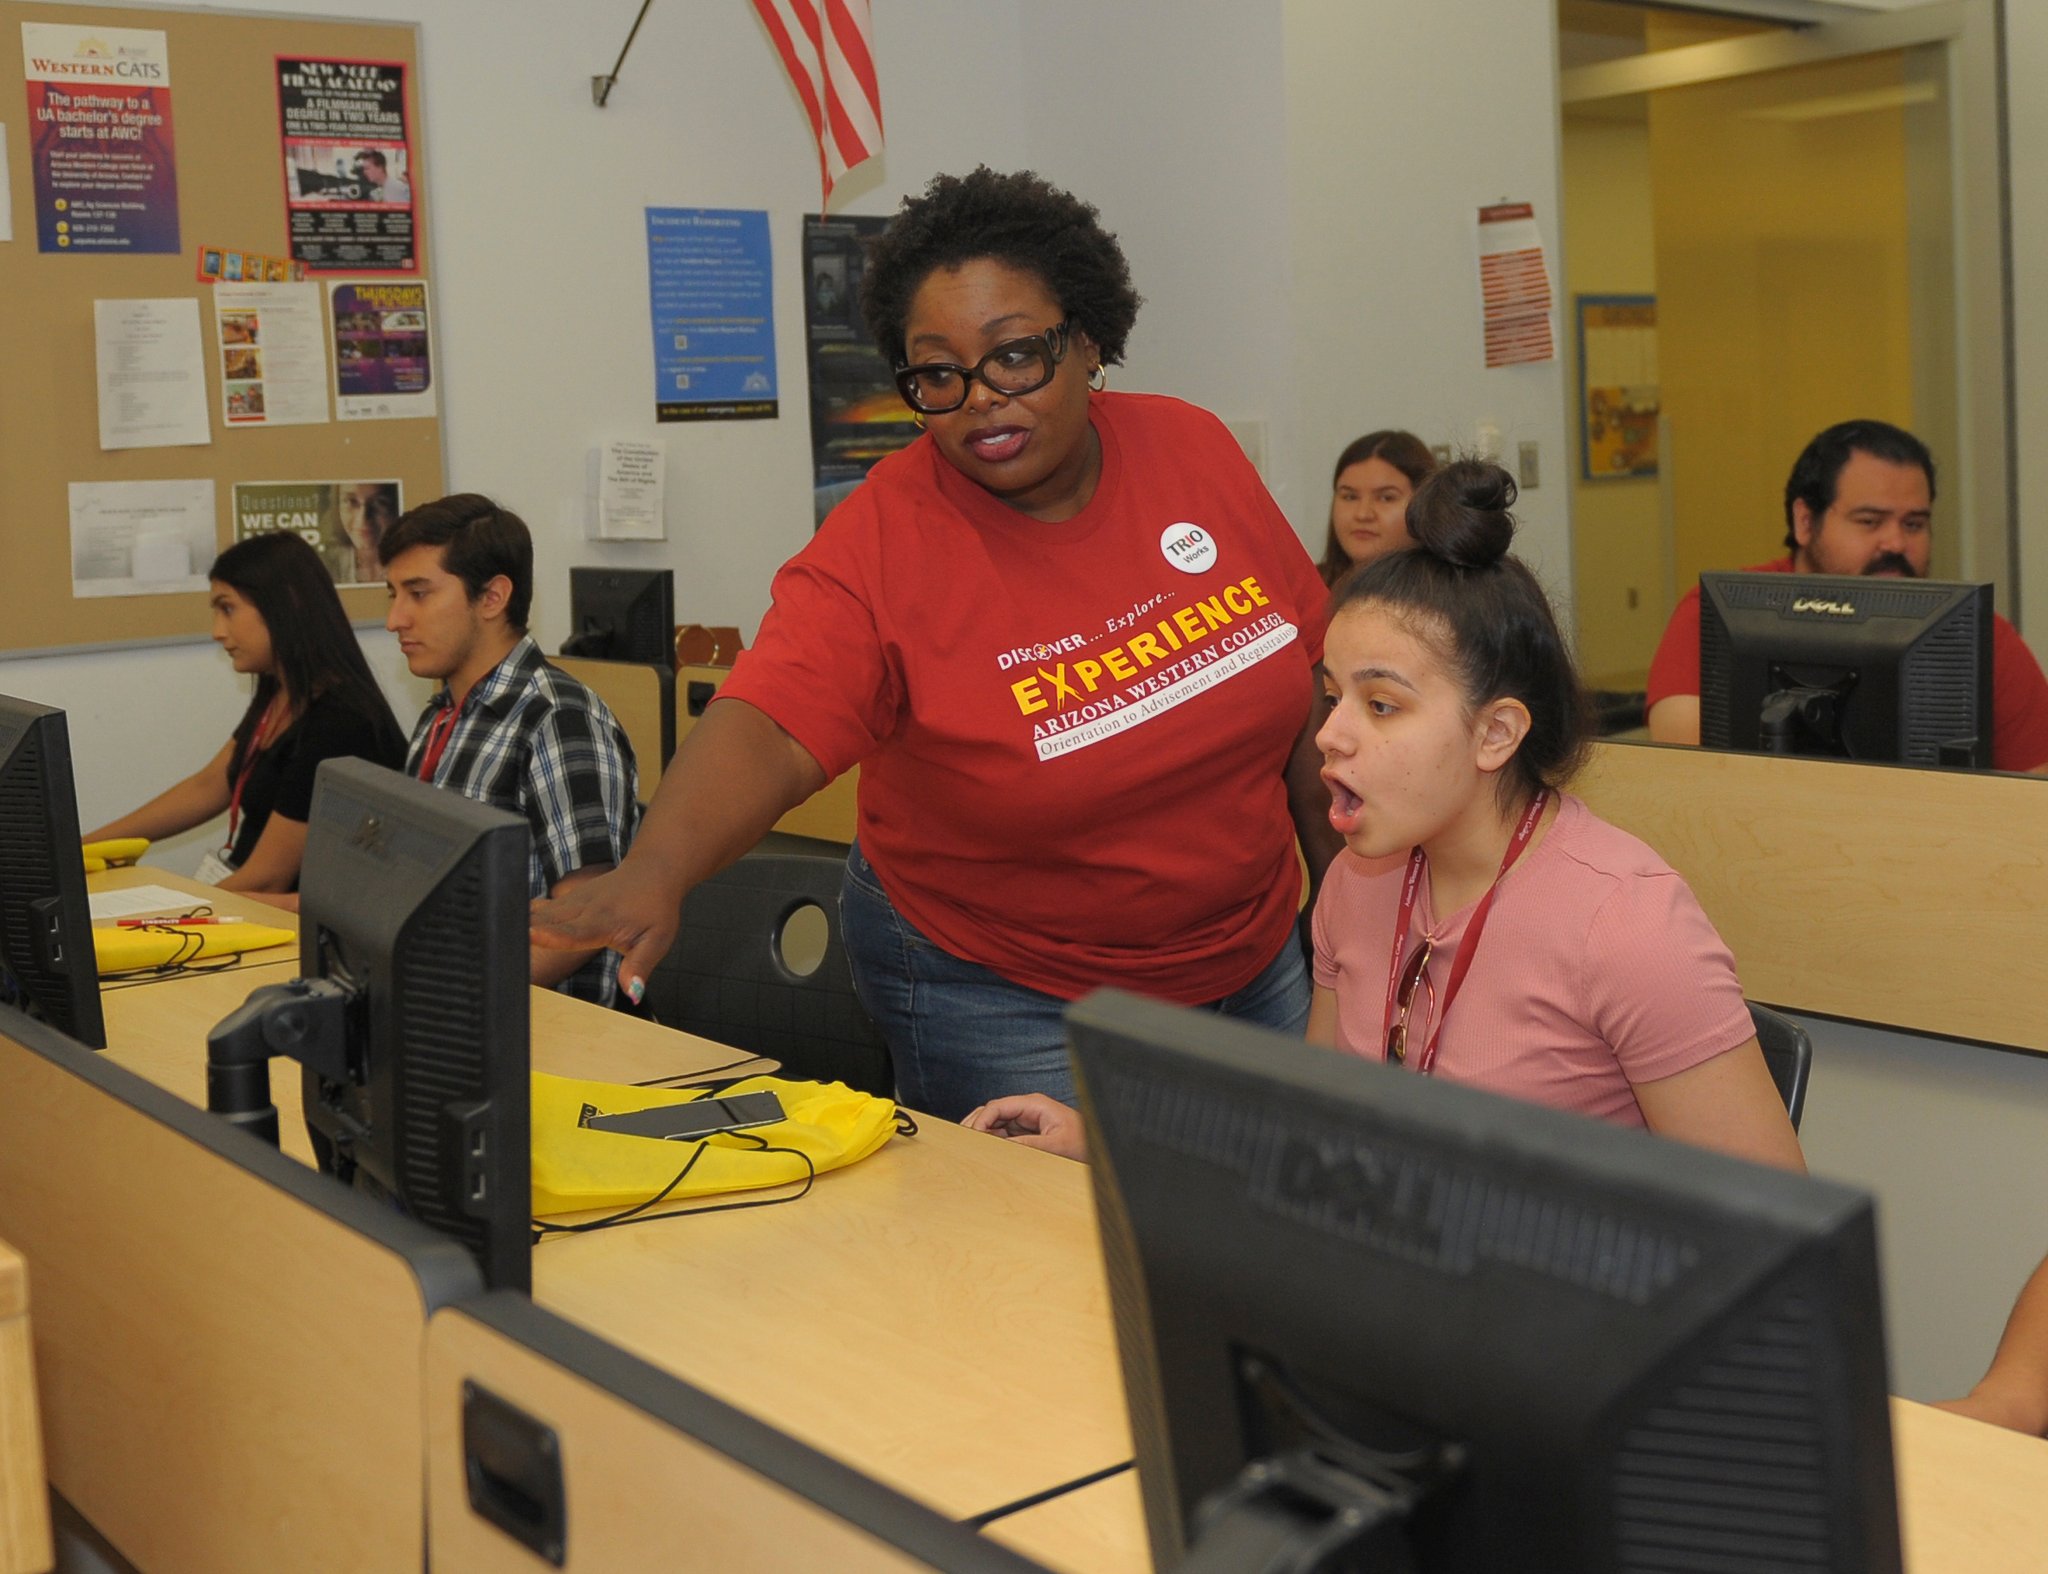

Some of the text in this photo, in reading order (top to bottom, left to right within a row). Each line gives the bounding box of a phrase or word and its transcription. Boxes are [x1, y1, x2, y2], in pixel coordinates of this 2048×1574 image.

[300, 63, 334, 76] NEW
[282, 73, 397, 92] FILM ACADEMY
[48, 92, 151, 111] The pathway to a
[306, 98, 380, 112] A FILMMAKING
[36, 108, 163, 127] UA bachelor's degree
[286, 107, 400, 123] DEGREE IN TWO YEARS
[59, 125, 94, 139] starts
[96, 127, 109, 139] at
[241, 493, 319, 511] Questions?
[242, 511, 319, 529] WE CAN
[1182, 544, 1211, 565] Works
[1792, 597, 1857, 616] DELL
[1010, 576, 1271, 717] EXPERIENCE
[1032, 611, 1286, 740] ARIZONA WESTERN COLLEGE
[1040, 624, 1297, 757] Orientation to Advisement and Registration
